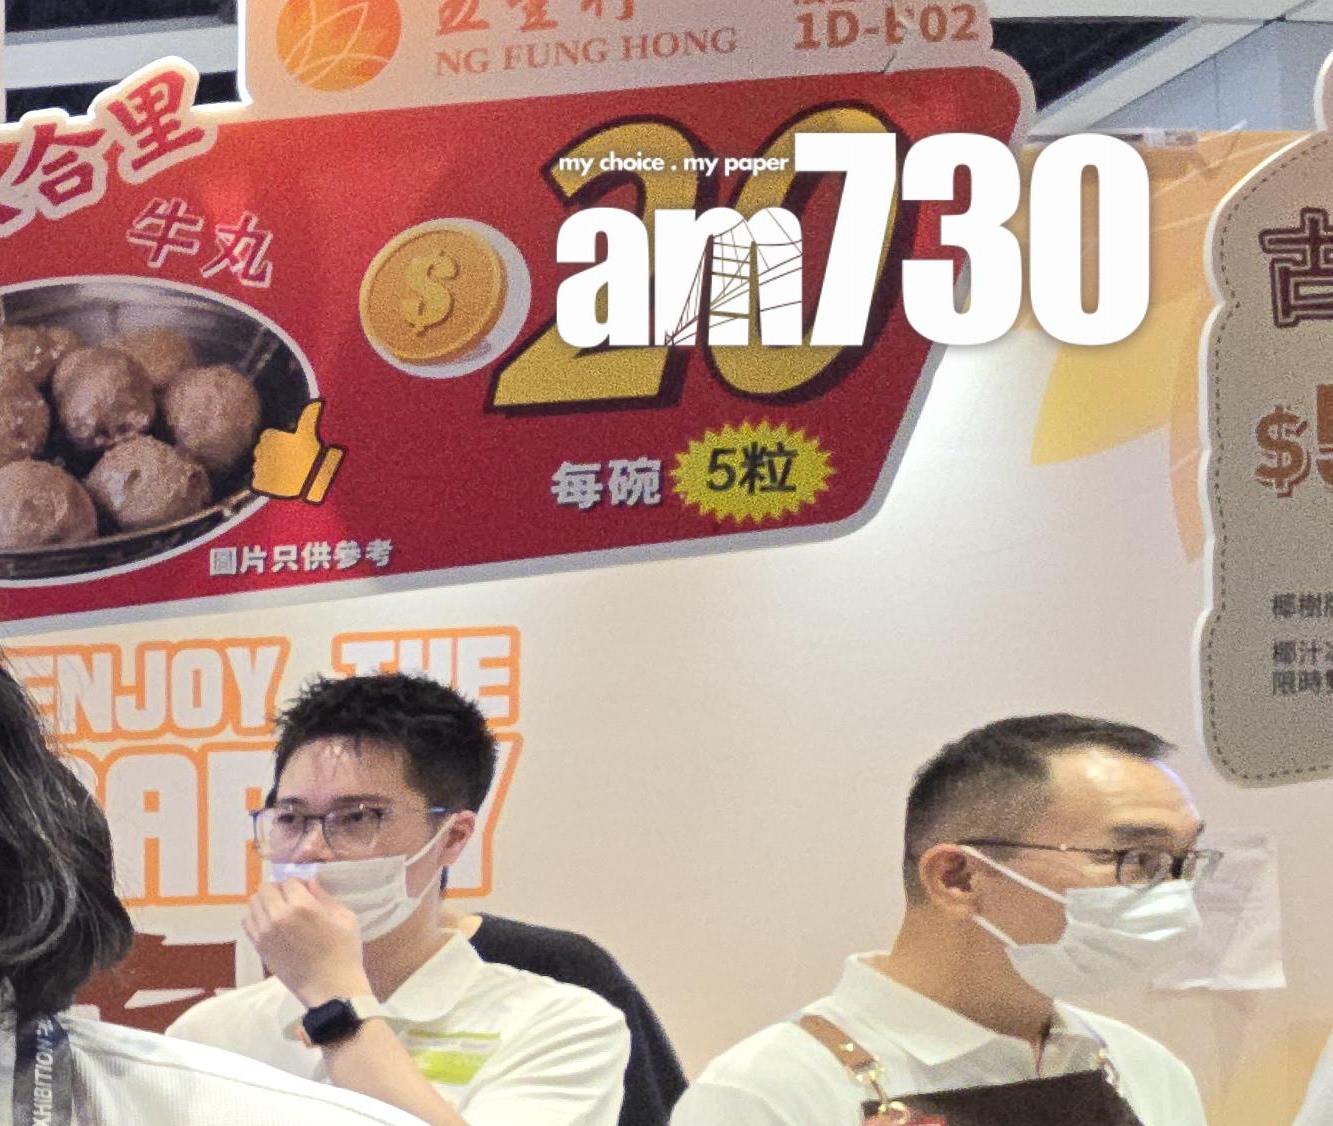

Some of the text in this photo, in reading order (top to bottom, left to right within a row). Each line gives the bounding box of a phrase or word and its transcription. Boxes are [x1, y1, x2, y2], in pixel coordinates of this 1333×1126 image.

[436, 27, 737, 76] NG FUNG HONG
[126, 197, 275, 289] 牛丸
[550, 457, 662, 509] 每碗
[705, 440, 799, 496] 5粒
[208, 538, 395, 577] 圖片只供參考
